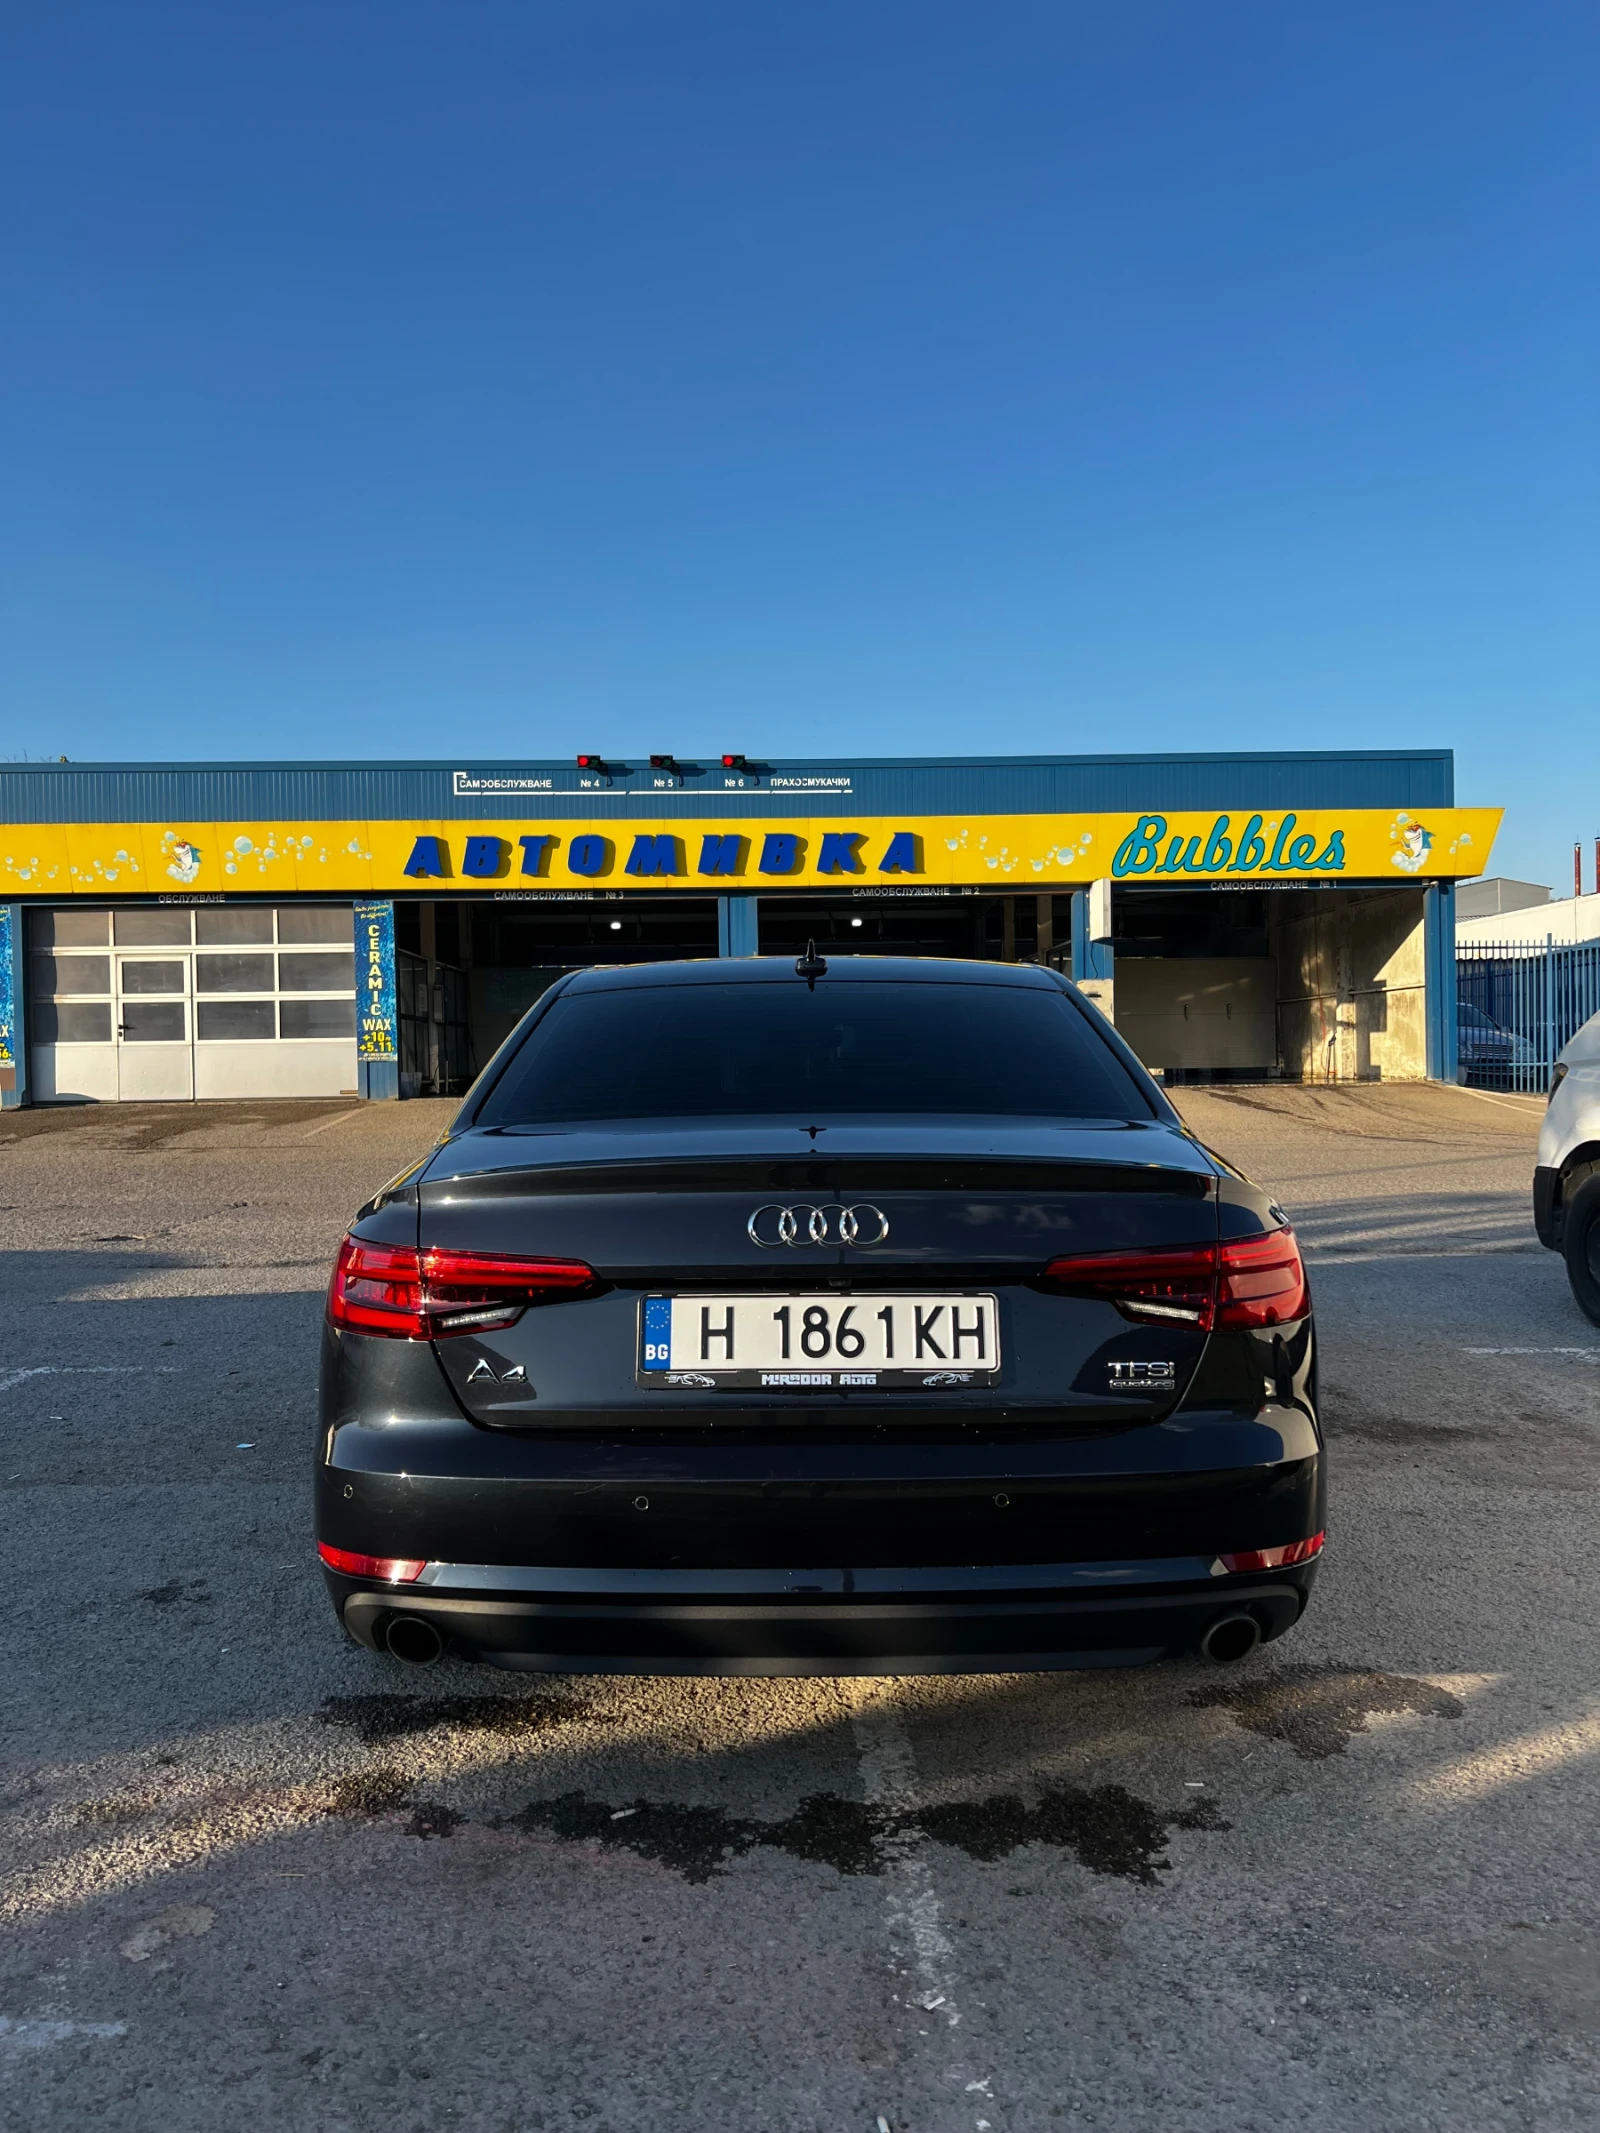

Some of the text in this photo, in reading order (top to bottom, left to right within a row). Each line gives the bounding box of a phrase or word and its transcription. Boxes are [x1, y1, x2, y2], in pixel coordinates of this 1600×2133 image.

[459, 778, 850, 788] САМООБСЛУЖВАНЕ № 4 № 5 № 6 ПРАХОСМУКАЧКИ
[1111, 813, 1346, 878] Bubbles
[402, 831, 920, 878] АВТОМИВКА
[852, 887, 950, 896] САМООБСЛУЖВАНЕ
[973, 886, 980, 895] 2
[1210, 880, 1309, 890] САМООБСЛУЖВАНЕ
[1332, 880, 1337, 888] 1
[158, 893, 225, 903] ОБСЛУЖВАНЕ
[494, 891, 594, 900] САМООБСЛУЖВАНЕ
[618, 891, 624, 899] 3
[368, 924, 383, 1016] CERAMIC
[363, 1018, 391, 1031] WAX
[700, 1306, 734, 1360] H
[645, 1344, 668, 1360] BG
[466, 1358, 528, 1384] A4
[1108, 1361, 1175, 1377] TFSI
